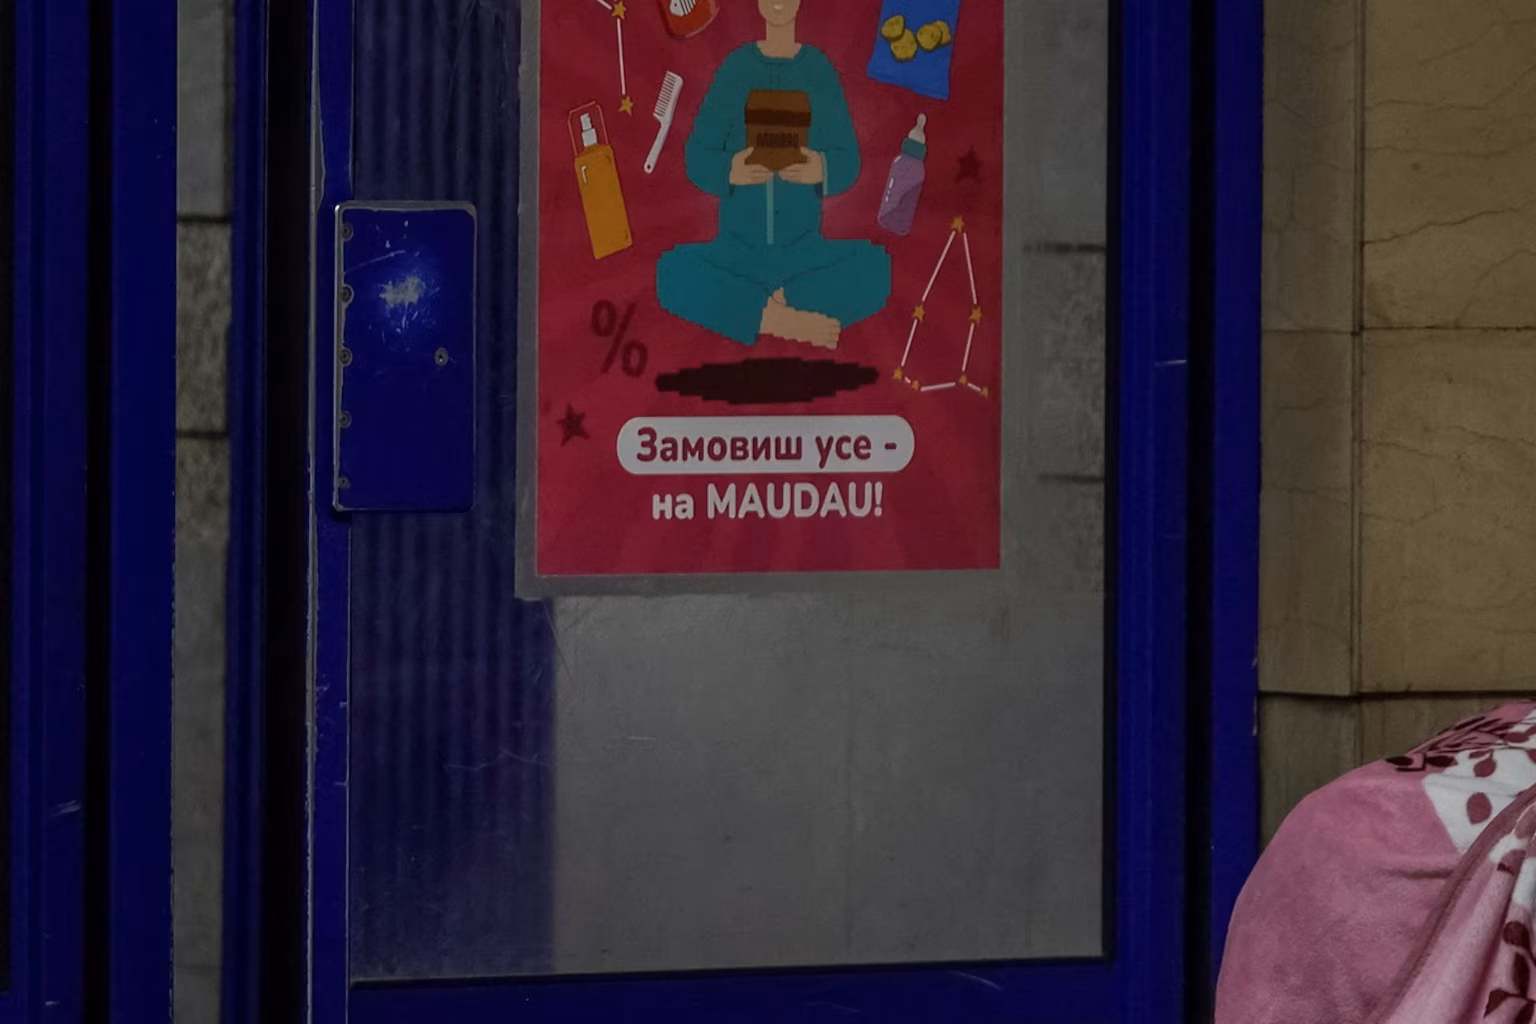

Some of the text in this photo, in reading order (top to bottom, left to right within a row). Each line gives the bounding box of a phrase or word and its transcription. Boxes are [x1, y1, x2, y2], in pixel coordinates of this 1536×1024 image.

[636, 426, 803, 463] Замовиш
[814, 435, 872, 470] усе
[651, 480, 884, 521] на MAUDAU!
